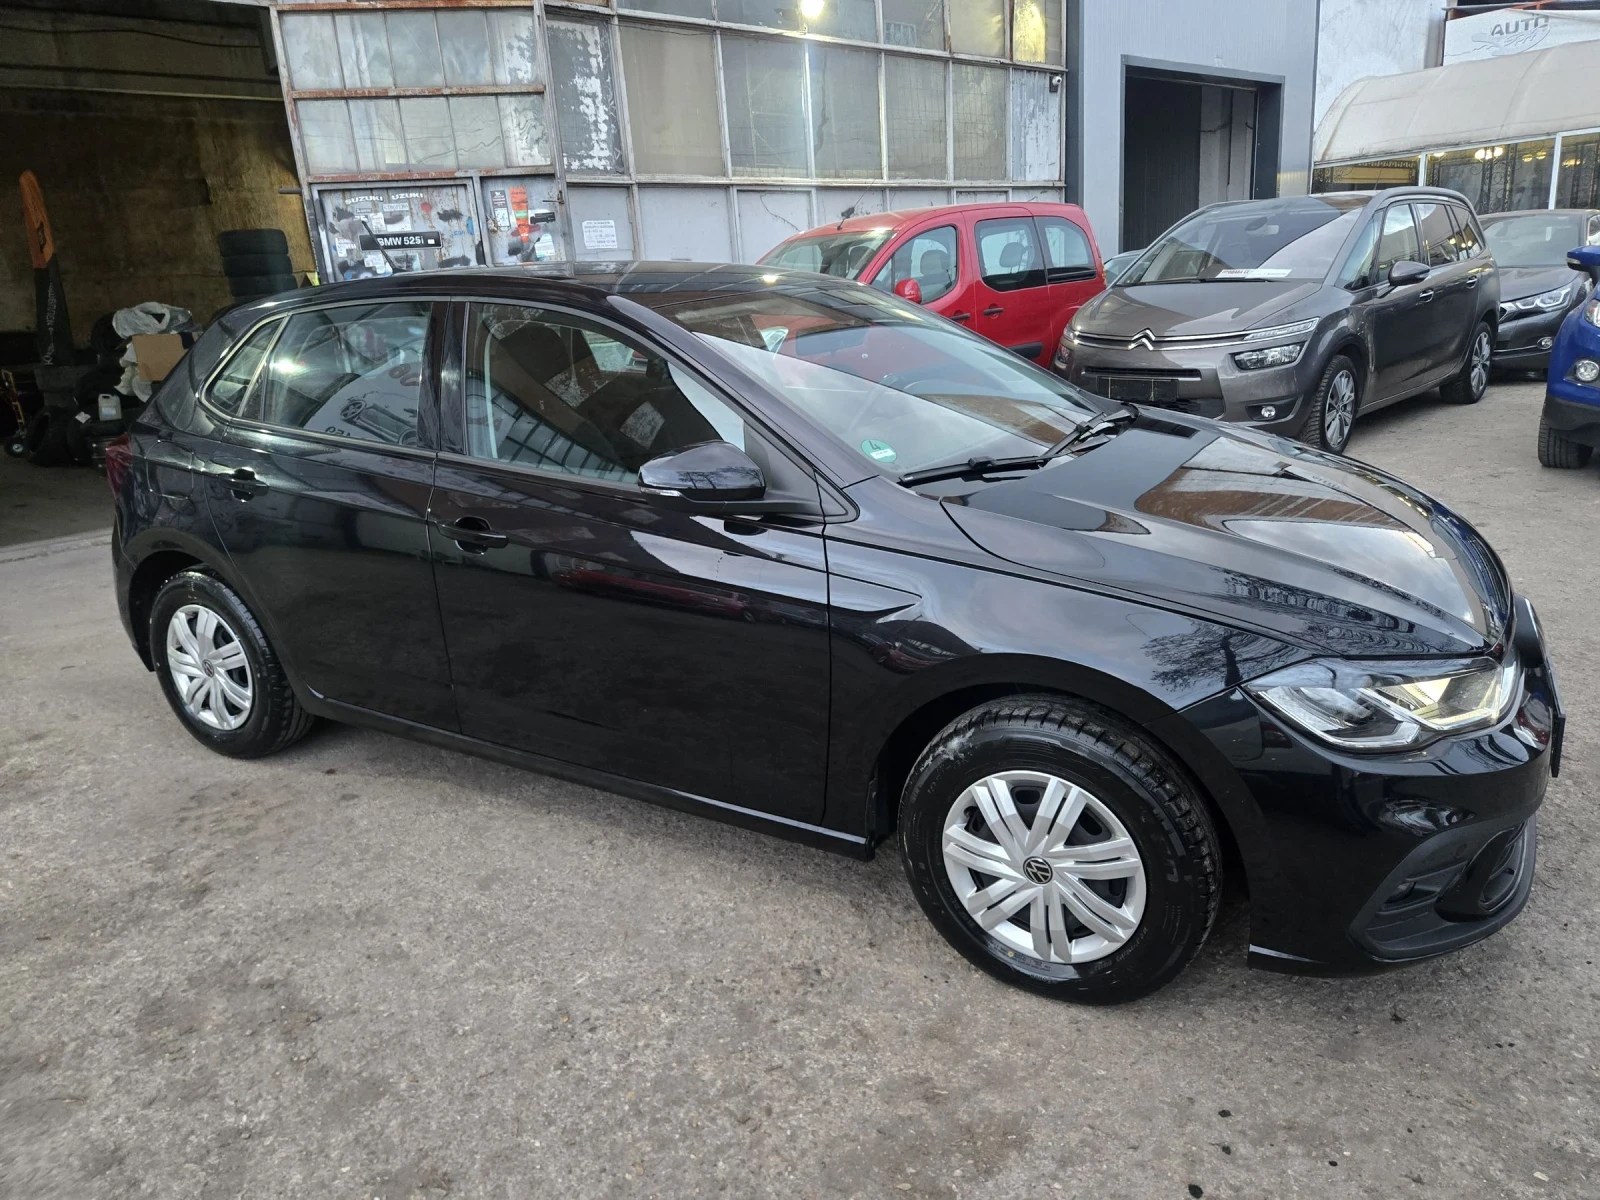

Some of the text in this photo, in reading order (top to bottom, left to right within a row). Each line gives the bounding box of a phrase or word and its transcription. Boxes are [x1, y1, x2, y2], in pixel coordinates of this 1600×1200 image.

[1491, 14, 1549, 37] AUTO
[345, 196, 383, 205] SUZUKI
[391, 192, 424, 200] UZUKI
[376, 235, 424, 247] BMW 525i
